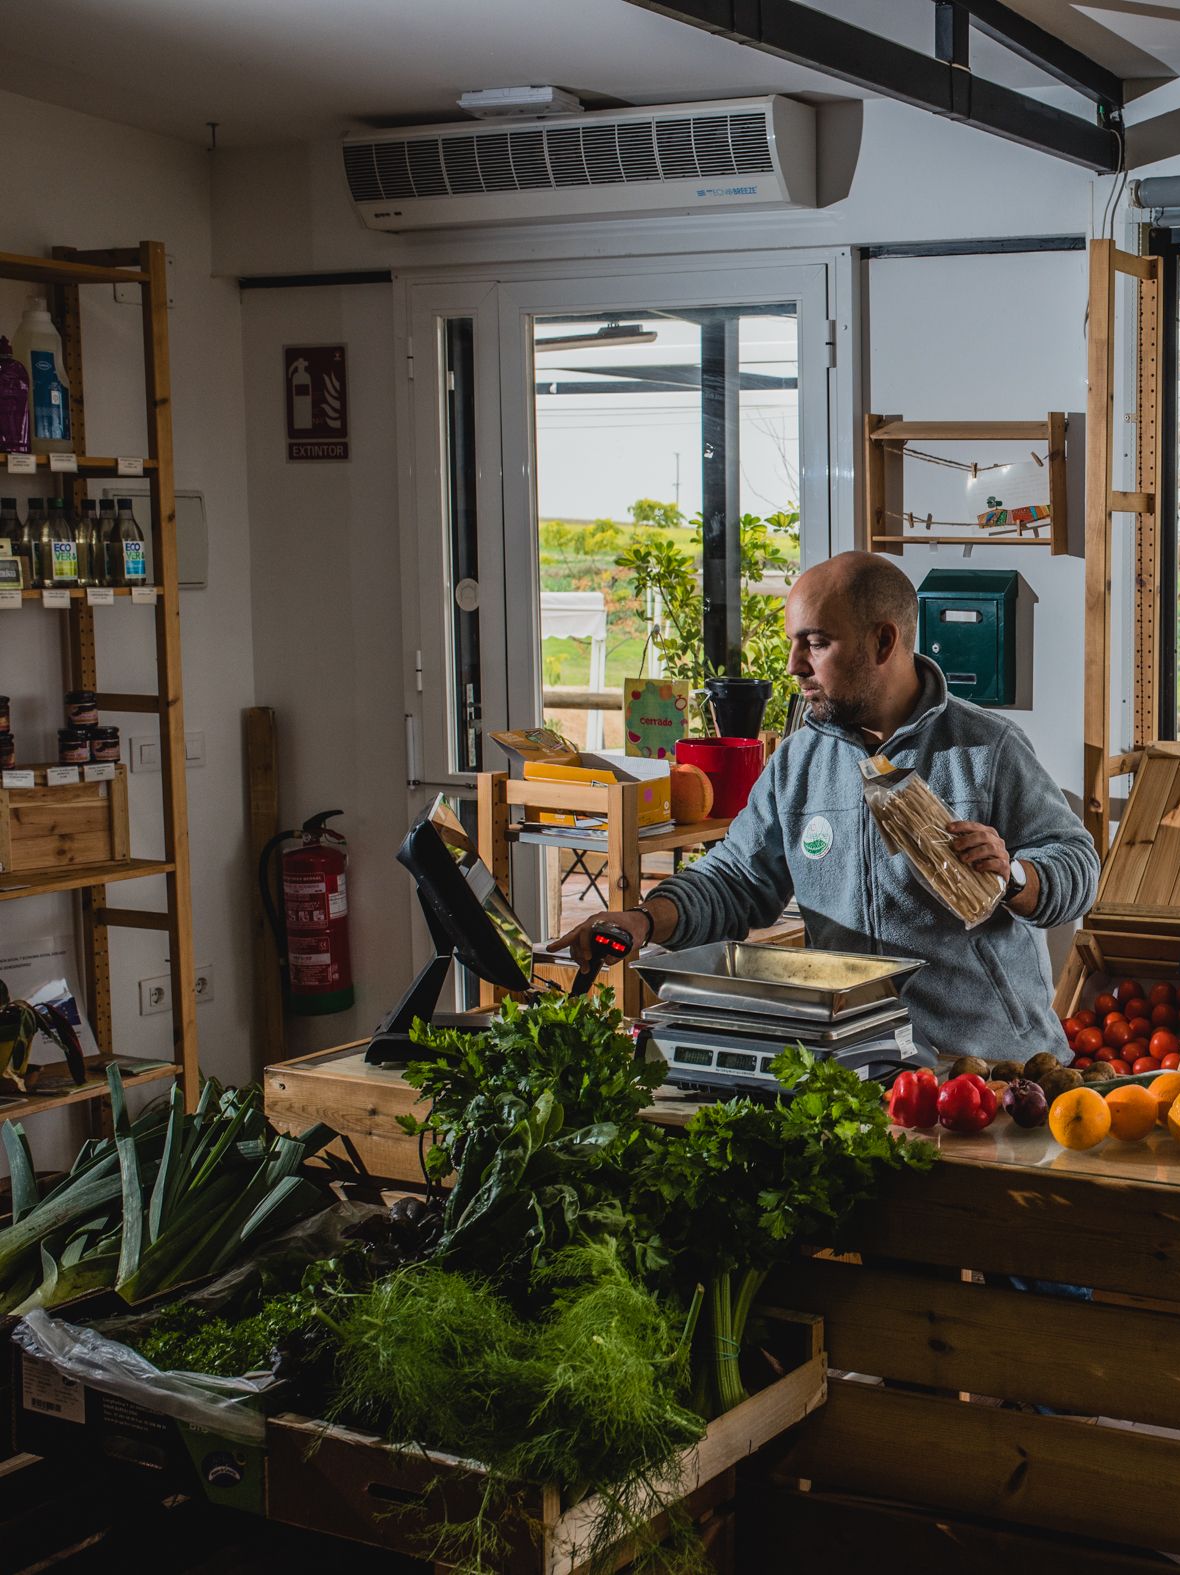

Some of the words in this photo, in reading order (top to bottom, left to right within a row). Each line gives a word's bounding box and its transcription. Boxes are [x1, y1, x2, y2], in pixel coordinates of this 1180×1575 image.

[293, 445, 344, 457] EXTINTOR
[54, 543, 71, 552] ECO
[125, 543, 140, 552] ECO
[640, 717, 672, 727] cerrado
